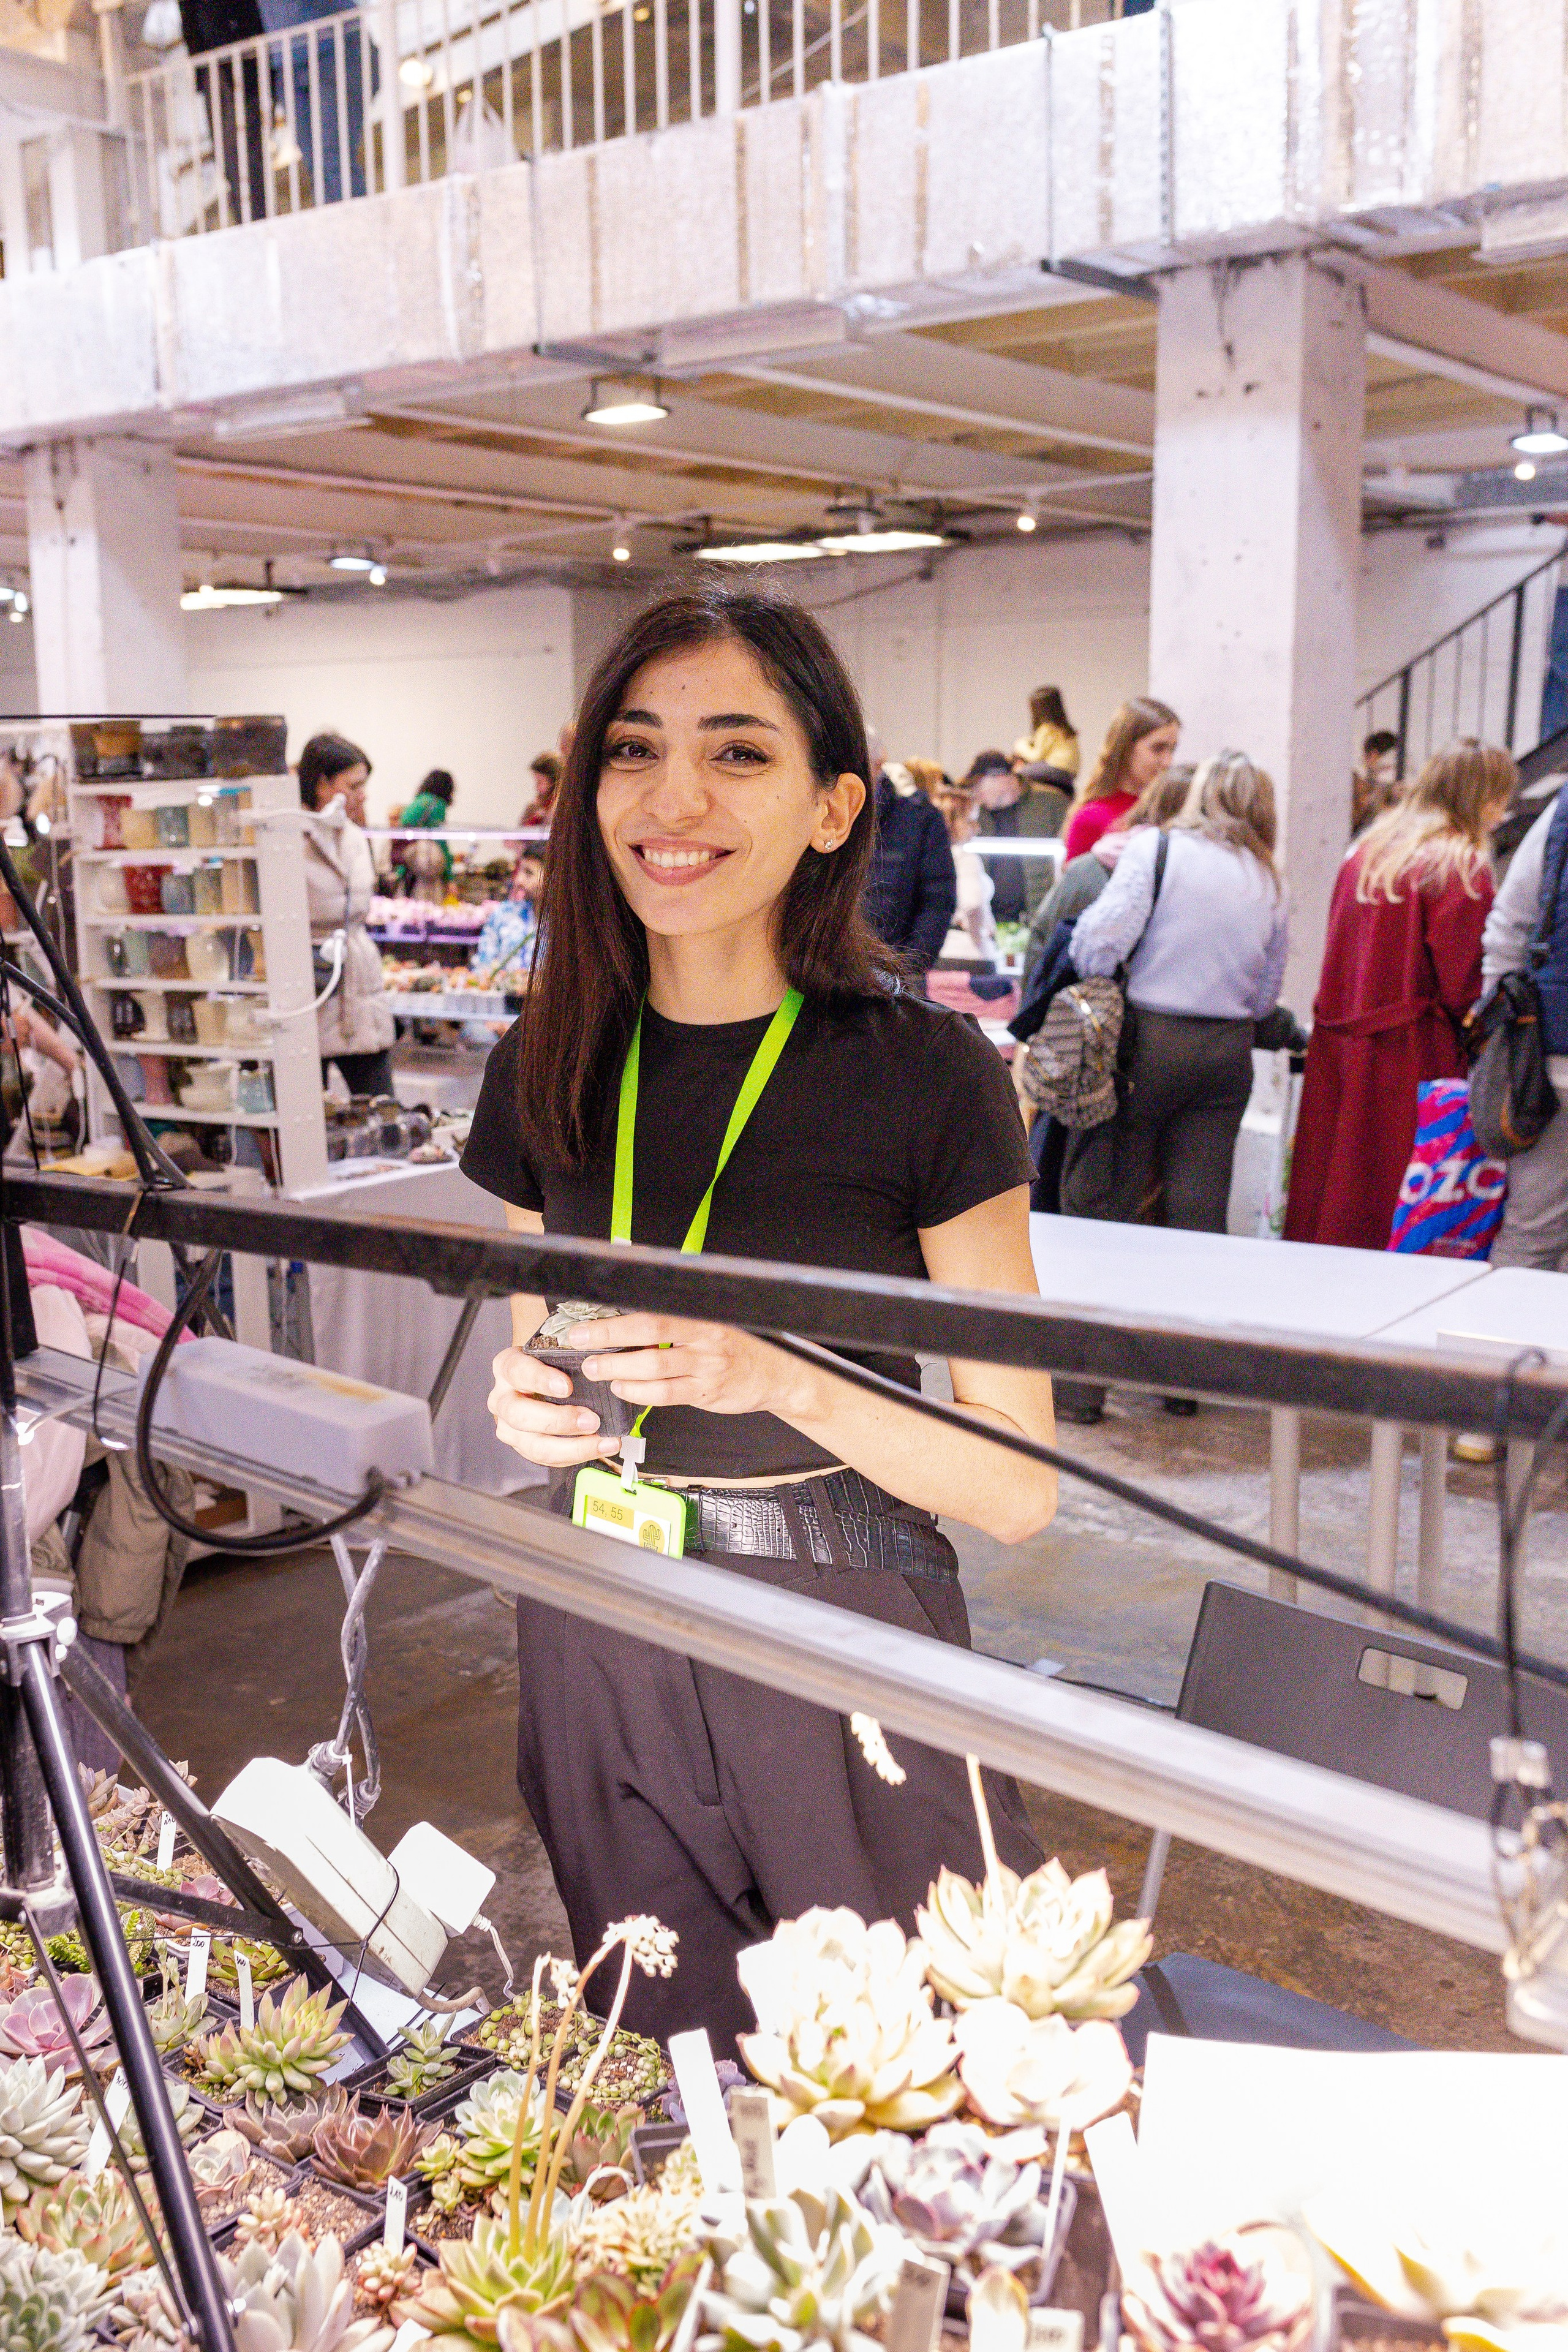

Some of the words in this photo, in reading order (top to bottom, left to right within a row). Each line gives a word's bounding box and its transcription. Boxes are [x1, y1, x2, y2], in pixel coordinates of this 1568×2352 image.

[592, 1500, 607, 1517] 54,
[611, 1506, 623, 1520] 55
[192, 1936, 205, 1948] 200
